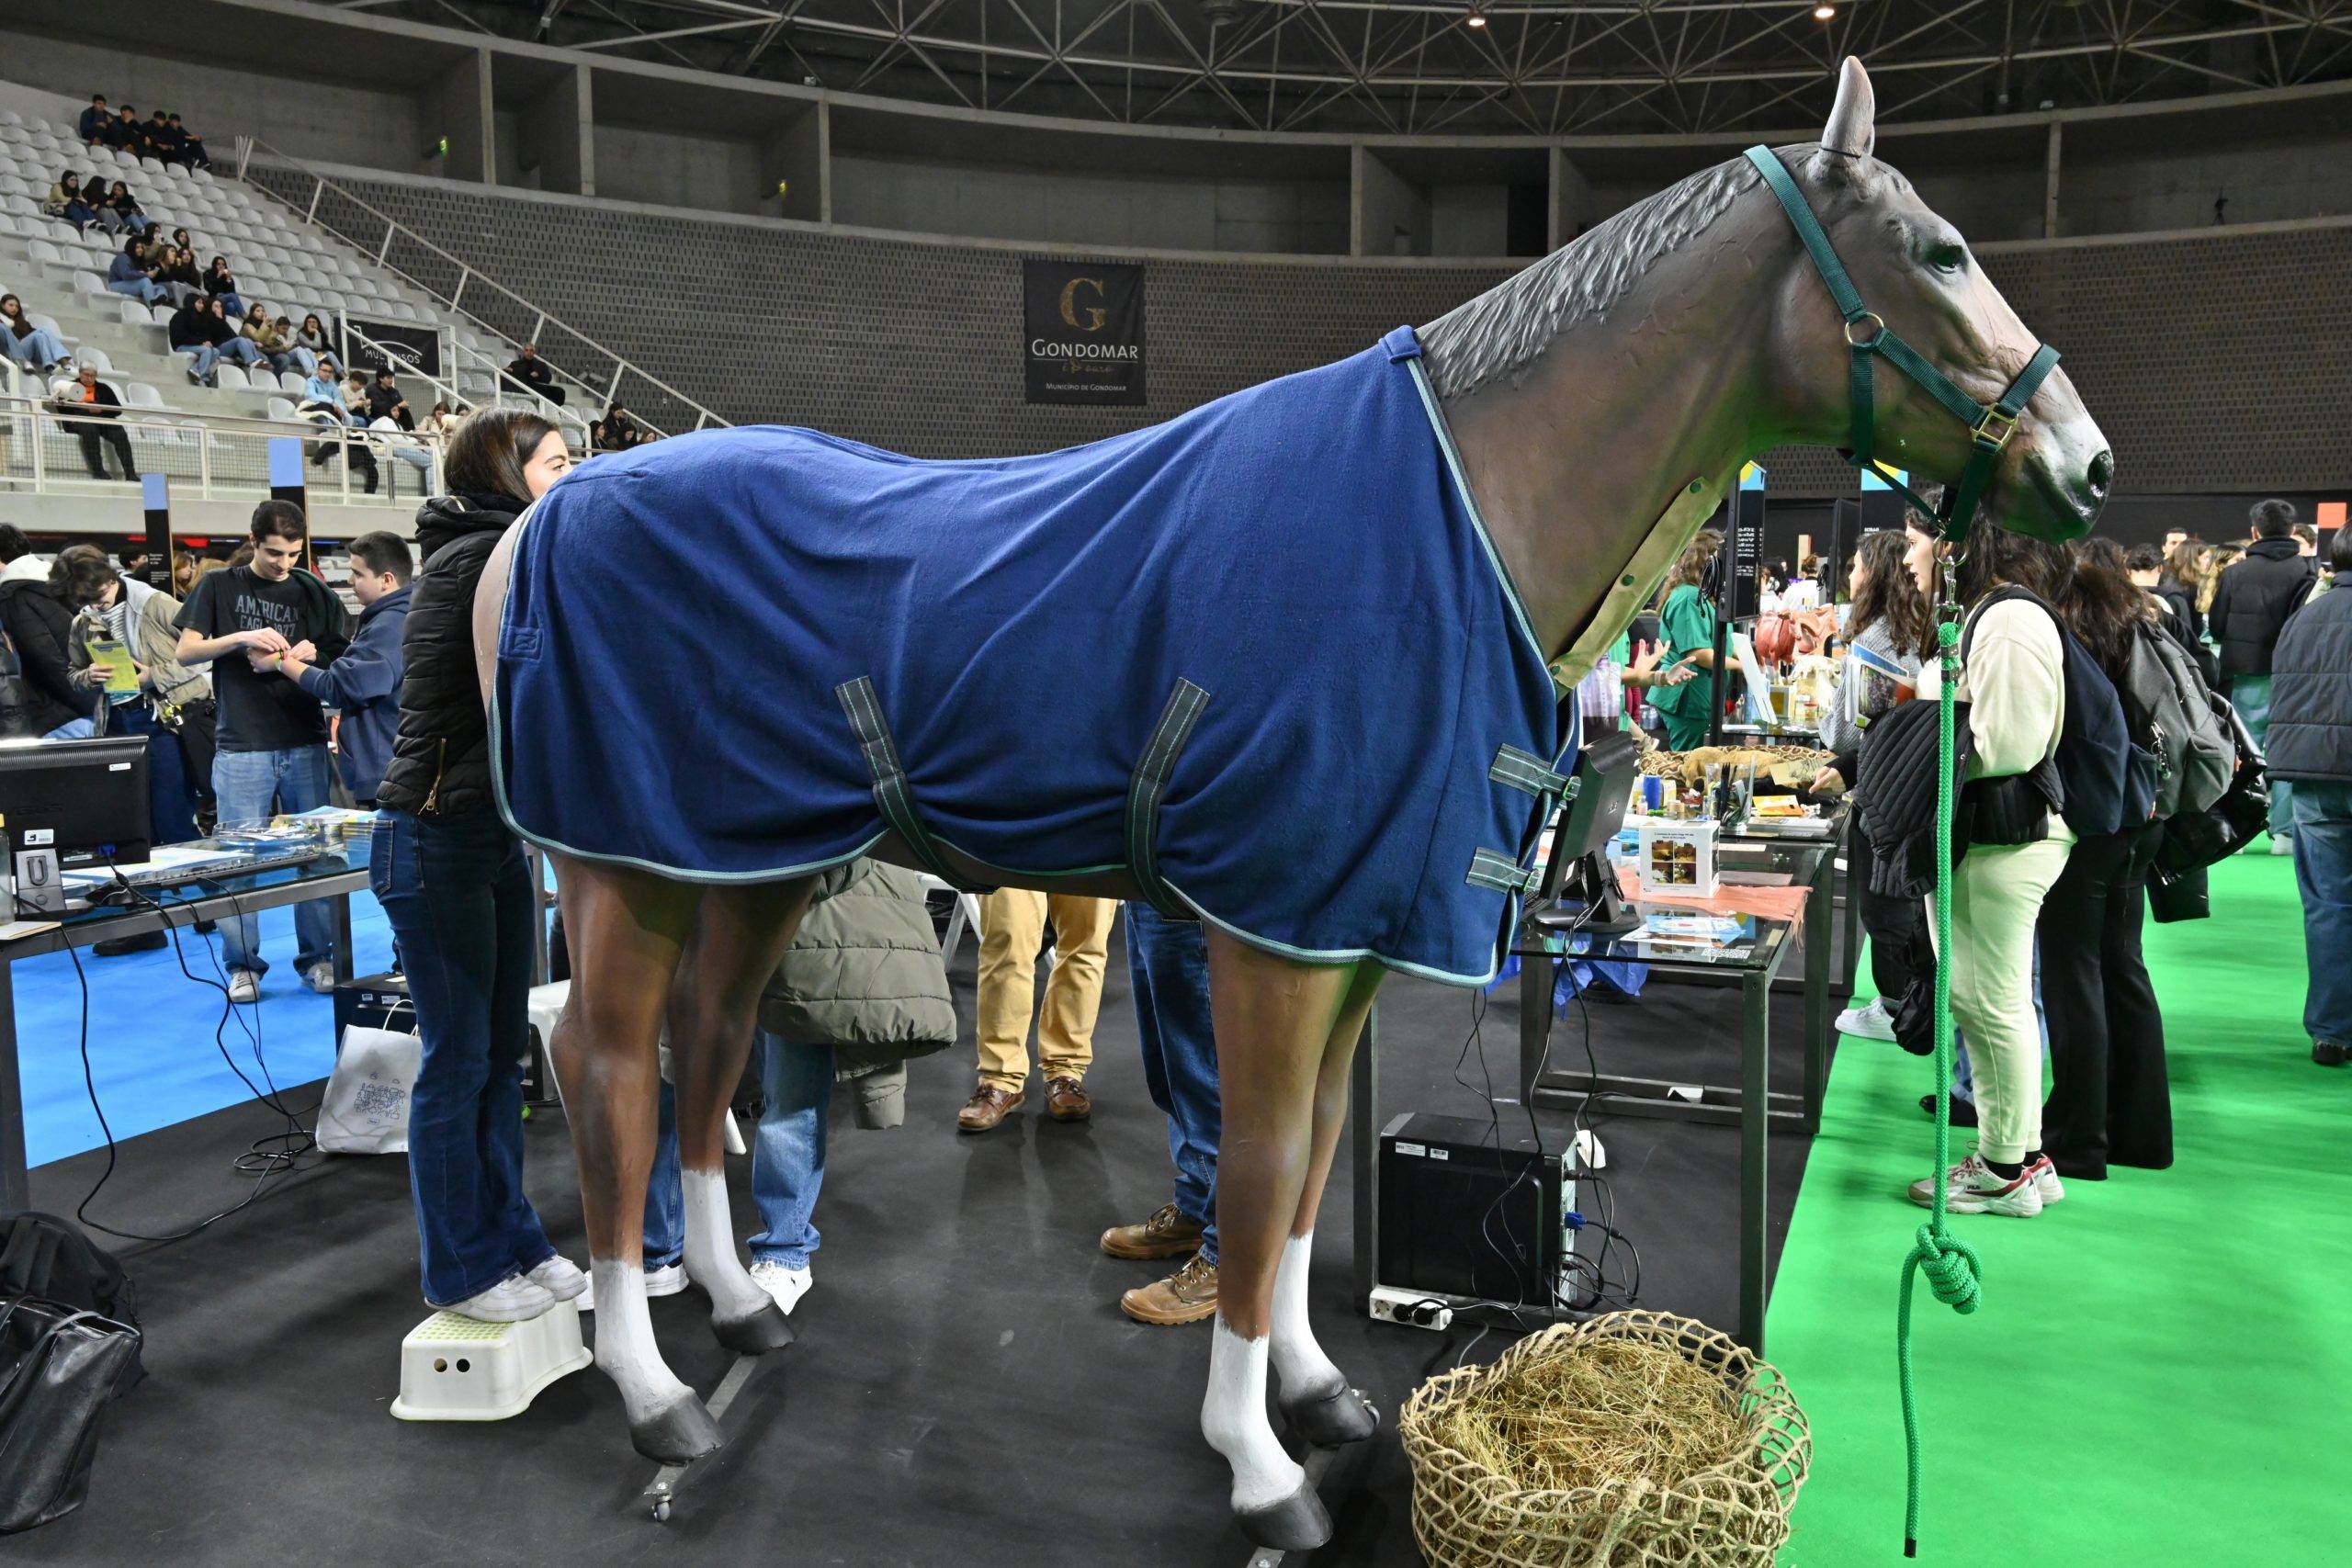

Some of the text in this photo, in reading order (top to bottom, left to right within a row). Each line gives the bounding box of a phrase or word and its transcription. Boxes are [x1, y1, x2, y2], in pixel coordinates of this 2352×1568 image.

[1060, 277, 1108, 332] G
[1032, 338, 1138, 359] GONDOMAR
[1090, 383, 1126, 392] GONDOMAR
[240, 615, 270, 631] EAGL
